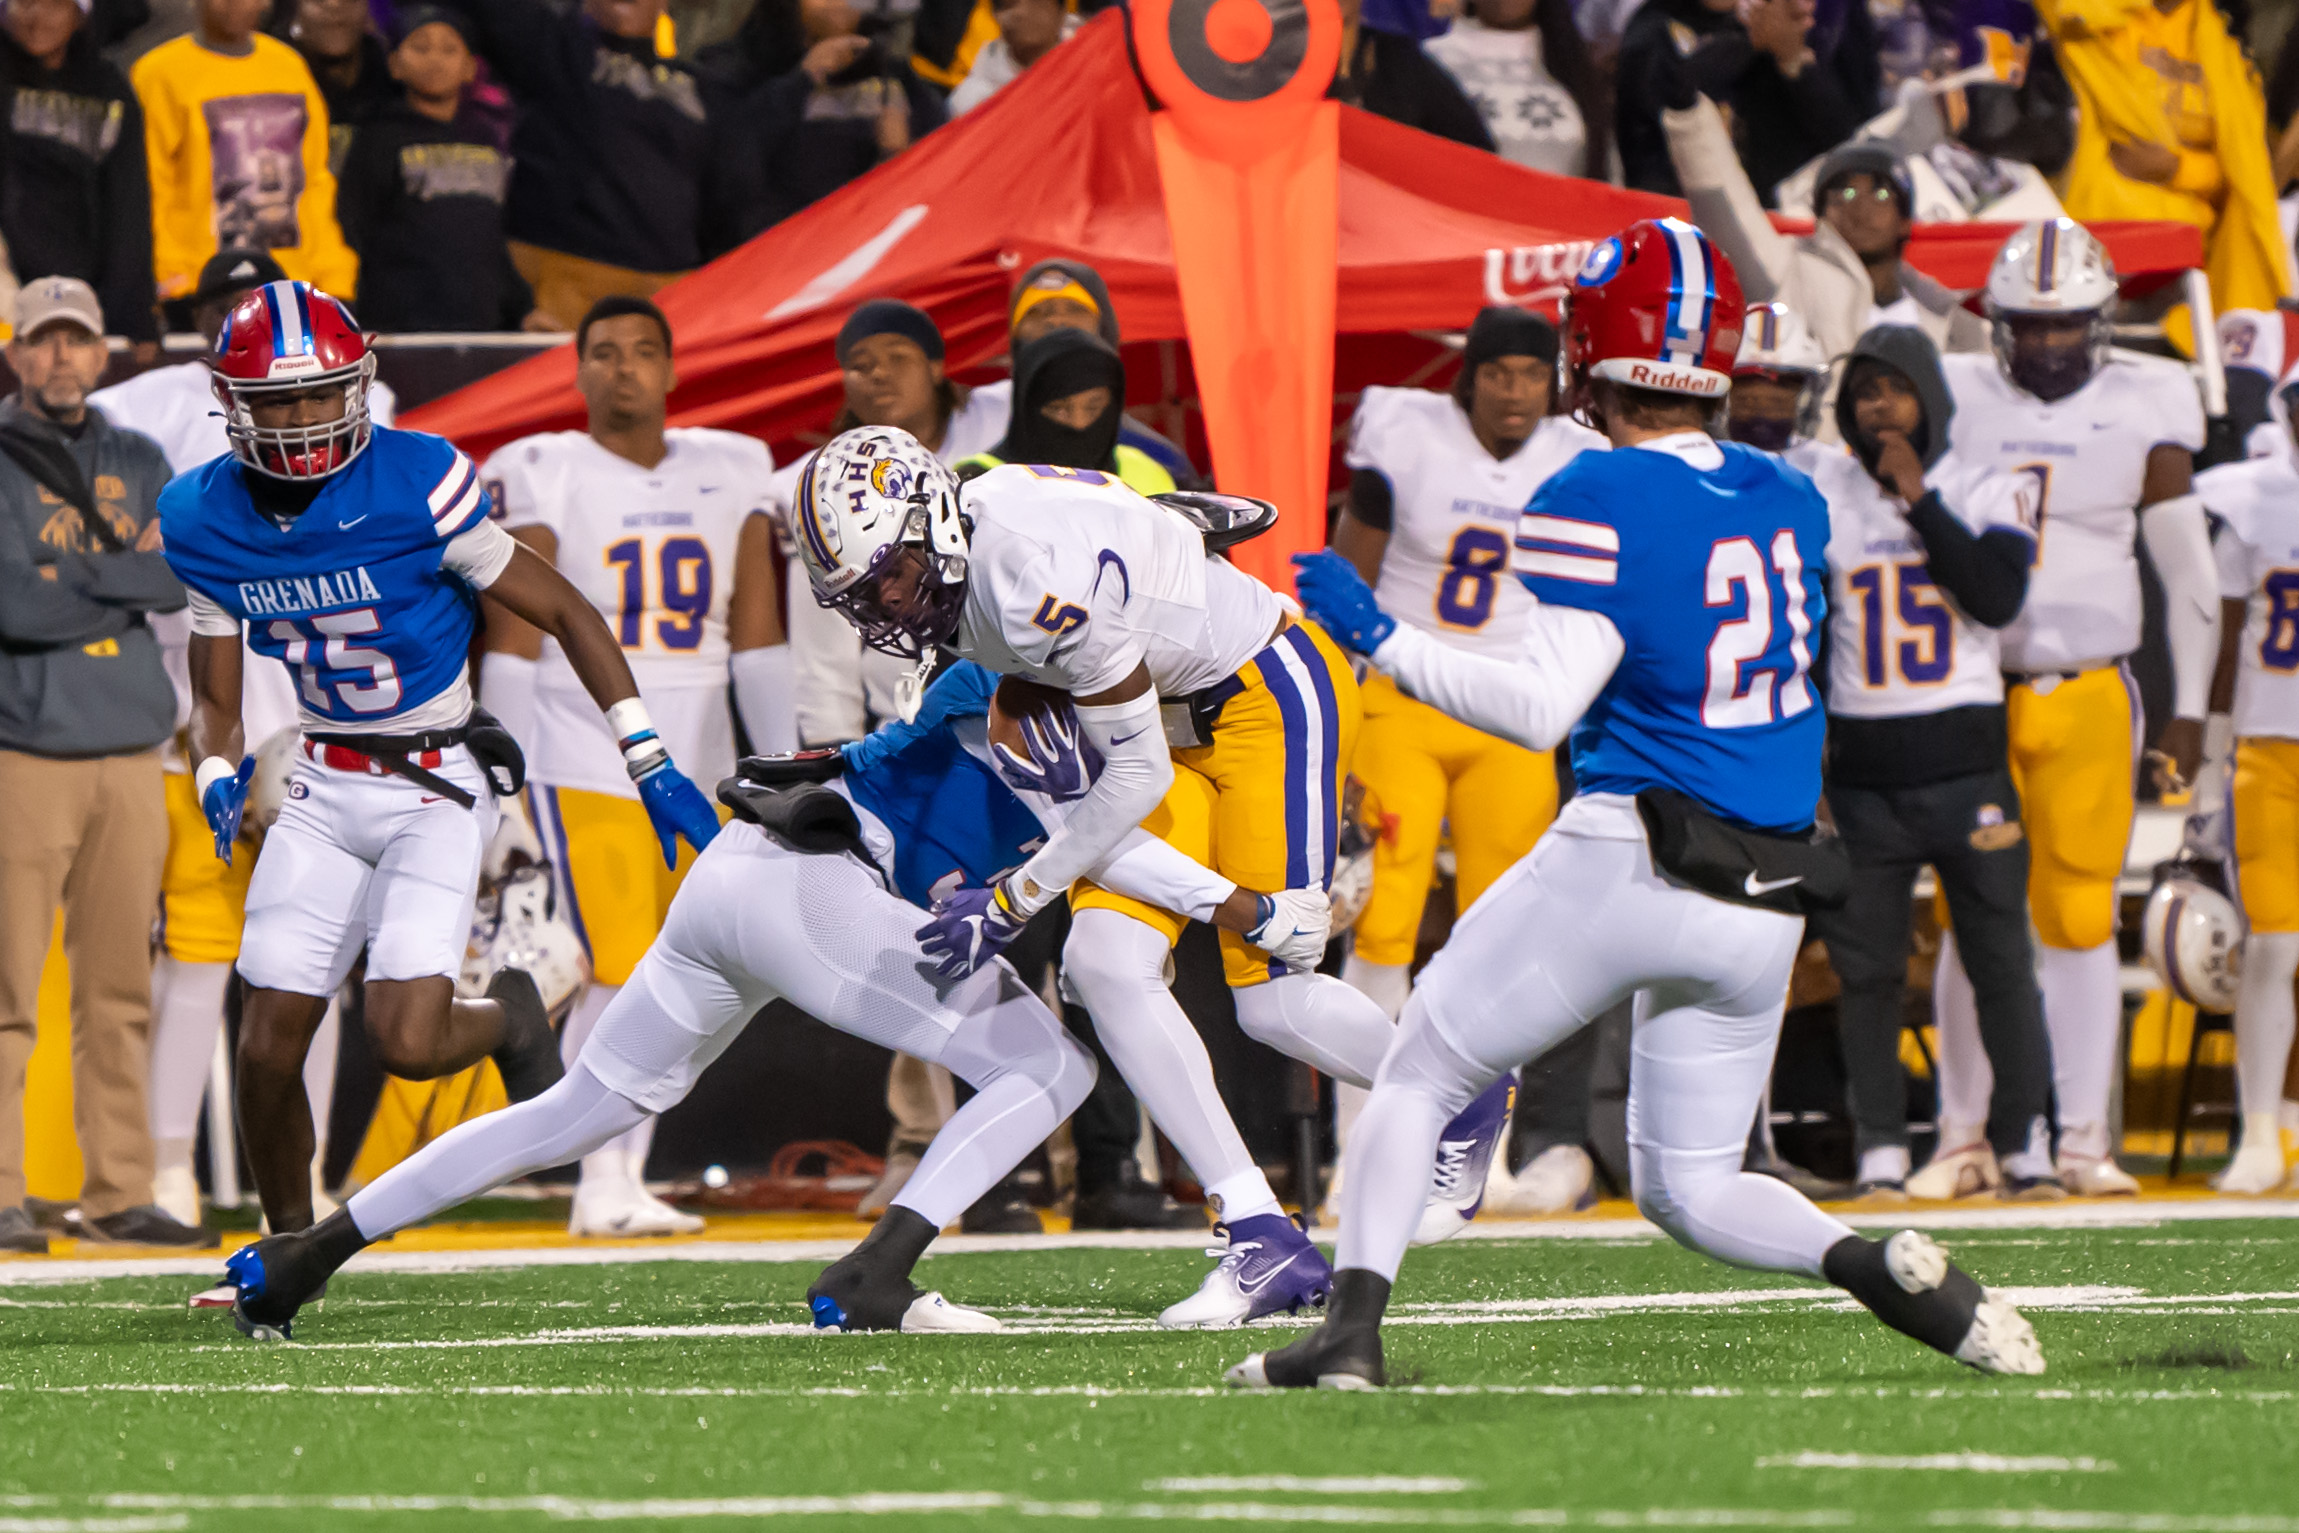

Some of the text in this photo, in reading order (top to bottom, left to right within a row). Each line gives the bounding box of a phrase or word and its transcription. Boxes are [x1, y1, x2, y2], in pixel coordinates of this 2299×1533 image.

[1630, 365, 1718, 393] Riddell
[848, 441, 877, 514] HHS
[238, 566, 382, 615] GRENADA
[603, 534, 713, 653] 19
[1029, 592, 1090, 636] 5
[1433, 523, 1511, 635] 8
[1700, 528, 1813, 728] 21
[1848, 560, 1957, 691] 15
[267, 606, 403, 714] 15
